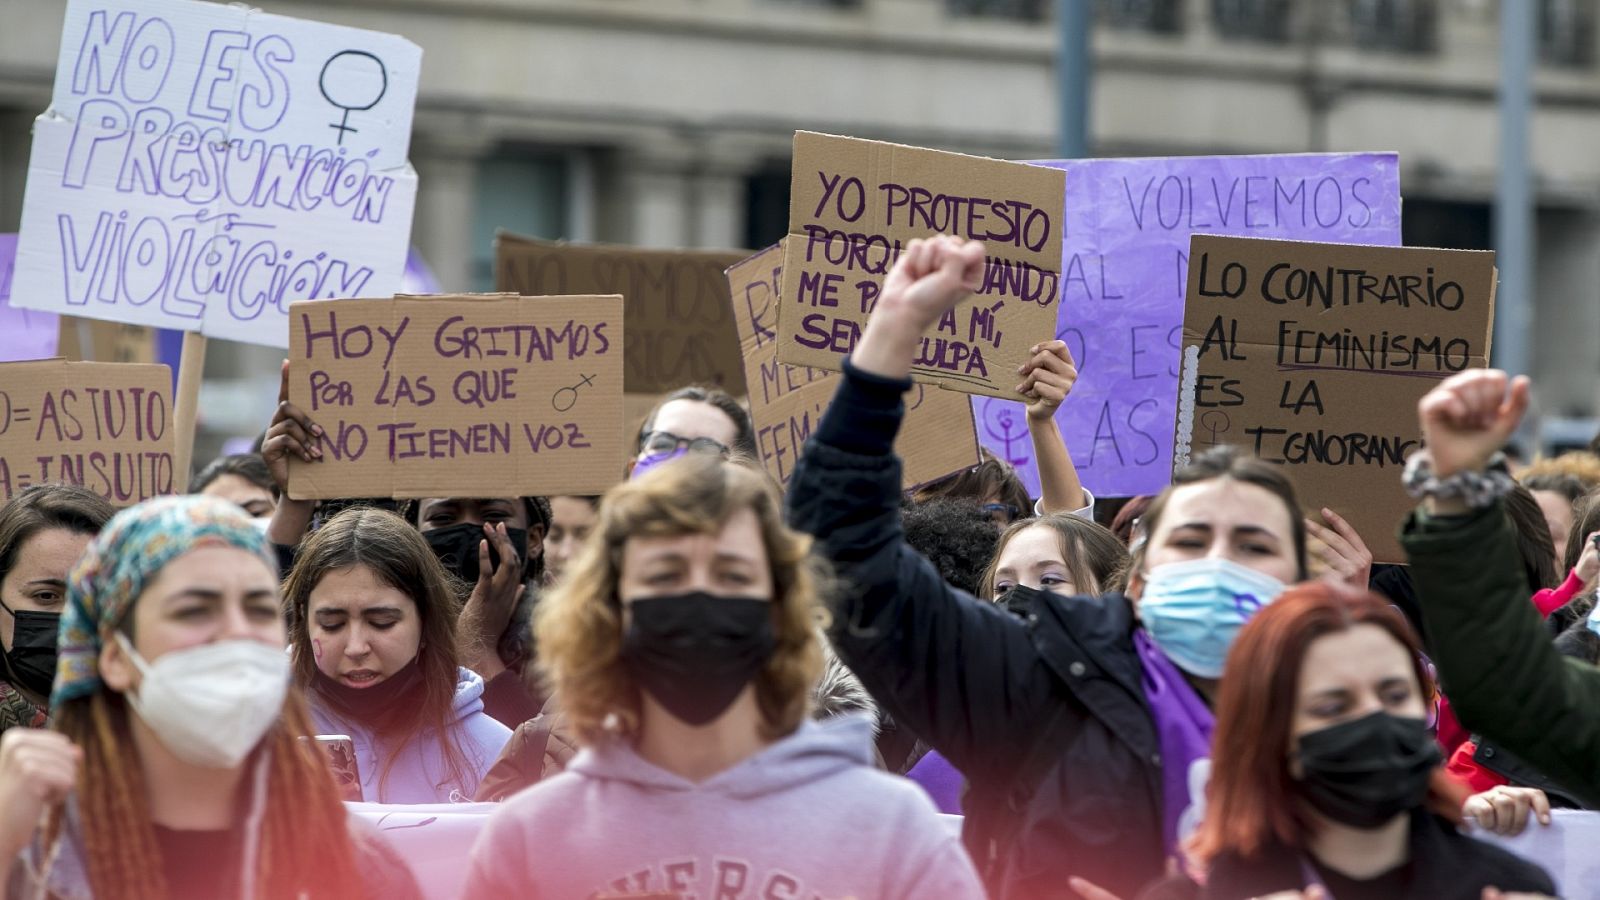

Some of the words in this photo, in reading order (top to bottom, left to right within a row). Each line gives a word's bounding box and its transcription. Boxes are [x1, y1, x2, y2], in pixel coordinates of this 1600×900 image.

[72, 10, 175, 103] NO
[188, 30, 295, 132] ES
[814, 171, 865, 223] YO
[879, 183, 1050, 252] PROTESTO
[1123, 175, 1371, 231] VOLVEMOS
[504, 252, 568, 294] NO
[803, 224, 901, 276] PORQ
[974, 255, 1059, 308] UANDO
[1199, 252, 1247, 299] LO
[798, 270, 844, 307] ME
[938, 303, 957, 336] A
[302, 311, 410, 369] HOY
[434, 316, 609, 363] GRITAMOS
[1198, 315, 1246, 361] AL
[35, 387, 166, 442] ASTUTO
[310, 370, 354, 411] POR
[374, 370, 436, 408] LAS
[453, 368, 518, 408] QUE
[1194, 375, 1244, 407] ES
[1279, 380, 1324, 415] LA
[316, 420, 368, 463] NO
[377, 422, 511, 464] TIENEN
[523, 422, 591, 453] VOZ
[37, 451, 174, 501] INSULTO
